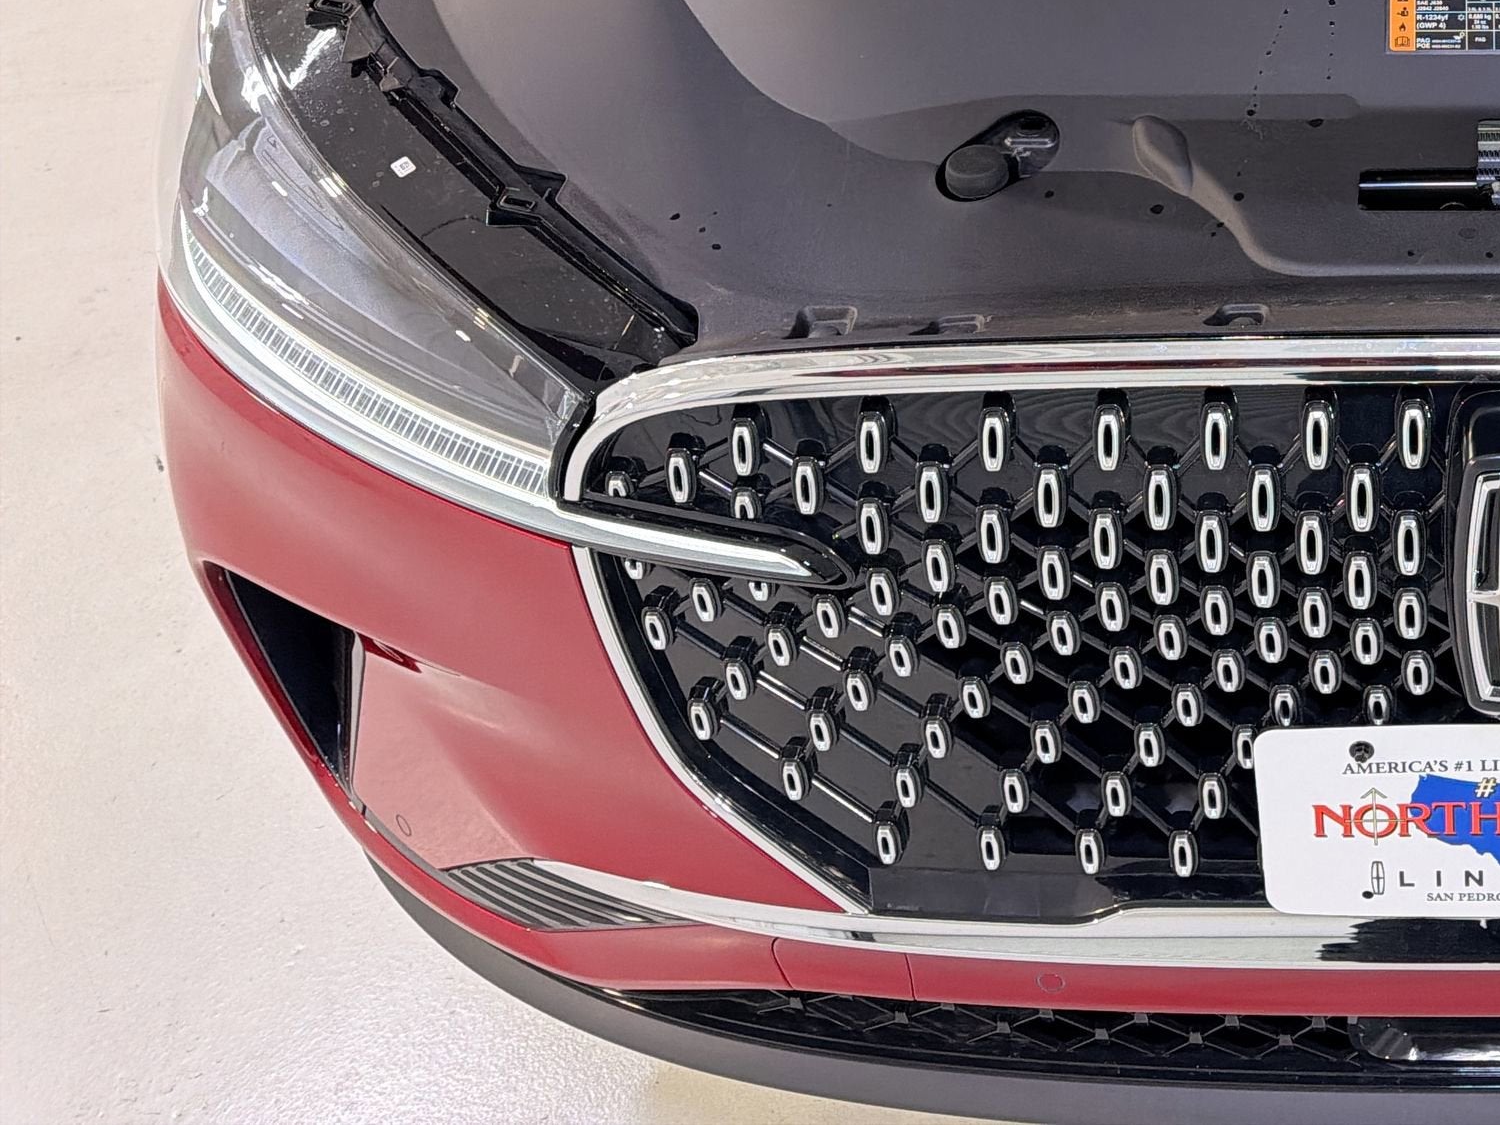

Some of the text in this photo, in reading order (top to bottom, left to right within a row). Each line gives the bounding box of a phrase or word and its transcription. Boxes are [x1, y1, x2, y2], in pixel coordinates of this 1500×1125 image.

[1416, 22, 1447, 30] (GWP 4)
[1342, 760, 1449, 774] AMERICA'S
[1454, 759, 1474, 772] #1
[1426, 892, 1454, 901] SAN
